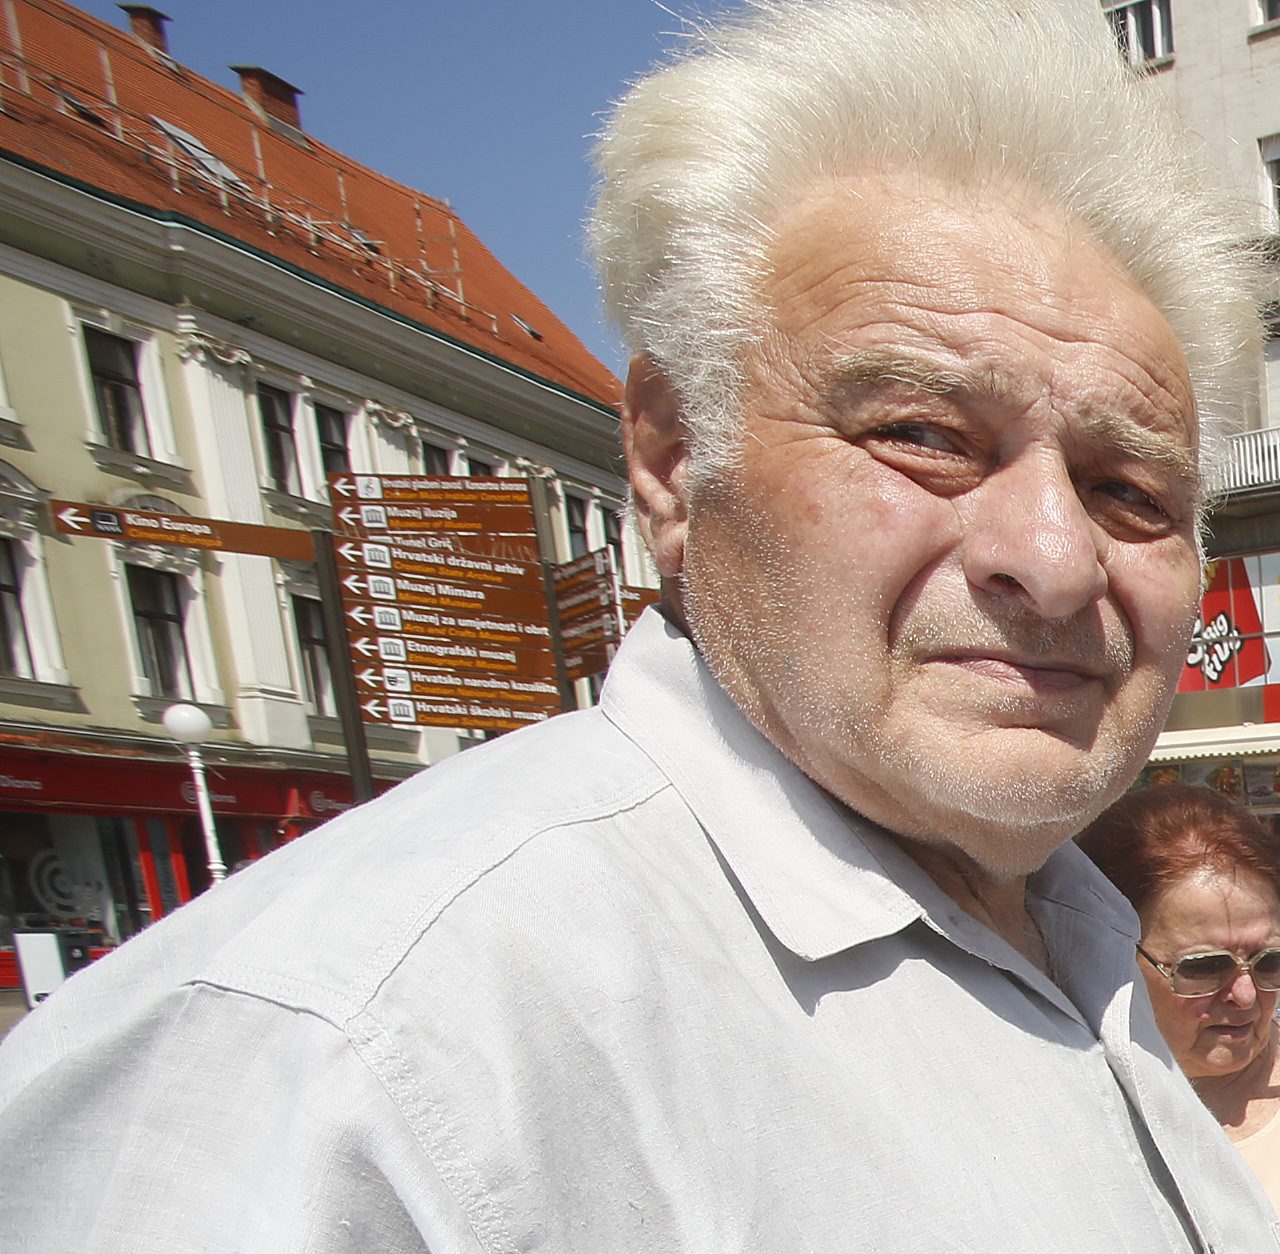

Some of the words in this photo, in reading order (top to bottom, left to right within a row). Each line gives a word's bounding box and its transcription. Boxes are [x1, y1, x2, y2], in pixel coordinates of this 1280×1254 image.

[124, 512, 159, 528] Kino
[160, 517, 212, 536] Europa
[386, 507, 422, 519] Muzej
[392, 548, 445, 565] Hrvatski
[446, 553, 492, 572] državni
[494, 562, 526, 576] arhiv
[396, 578, 436, 596] Muzej
[438, 584, 486, 600] Mimara
[401, 608, 440, 626] Muzej
[441, 615, 456, 626] za
[457, 617, 517, 632] umjetnost
[406, 641, 478, 658] Etnografski
[478, 650, 518, 664] muzej
[411, 672, 463, 686] Hrvatsko
[415, 700, 469, 715] Hrvatski
